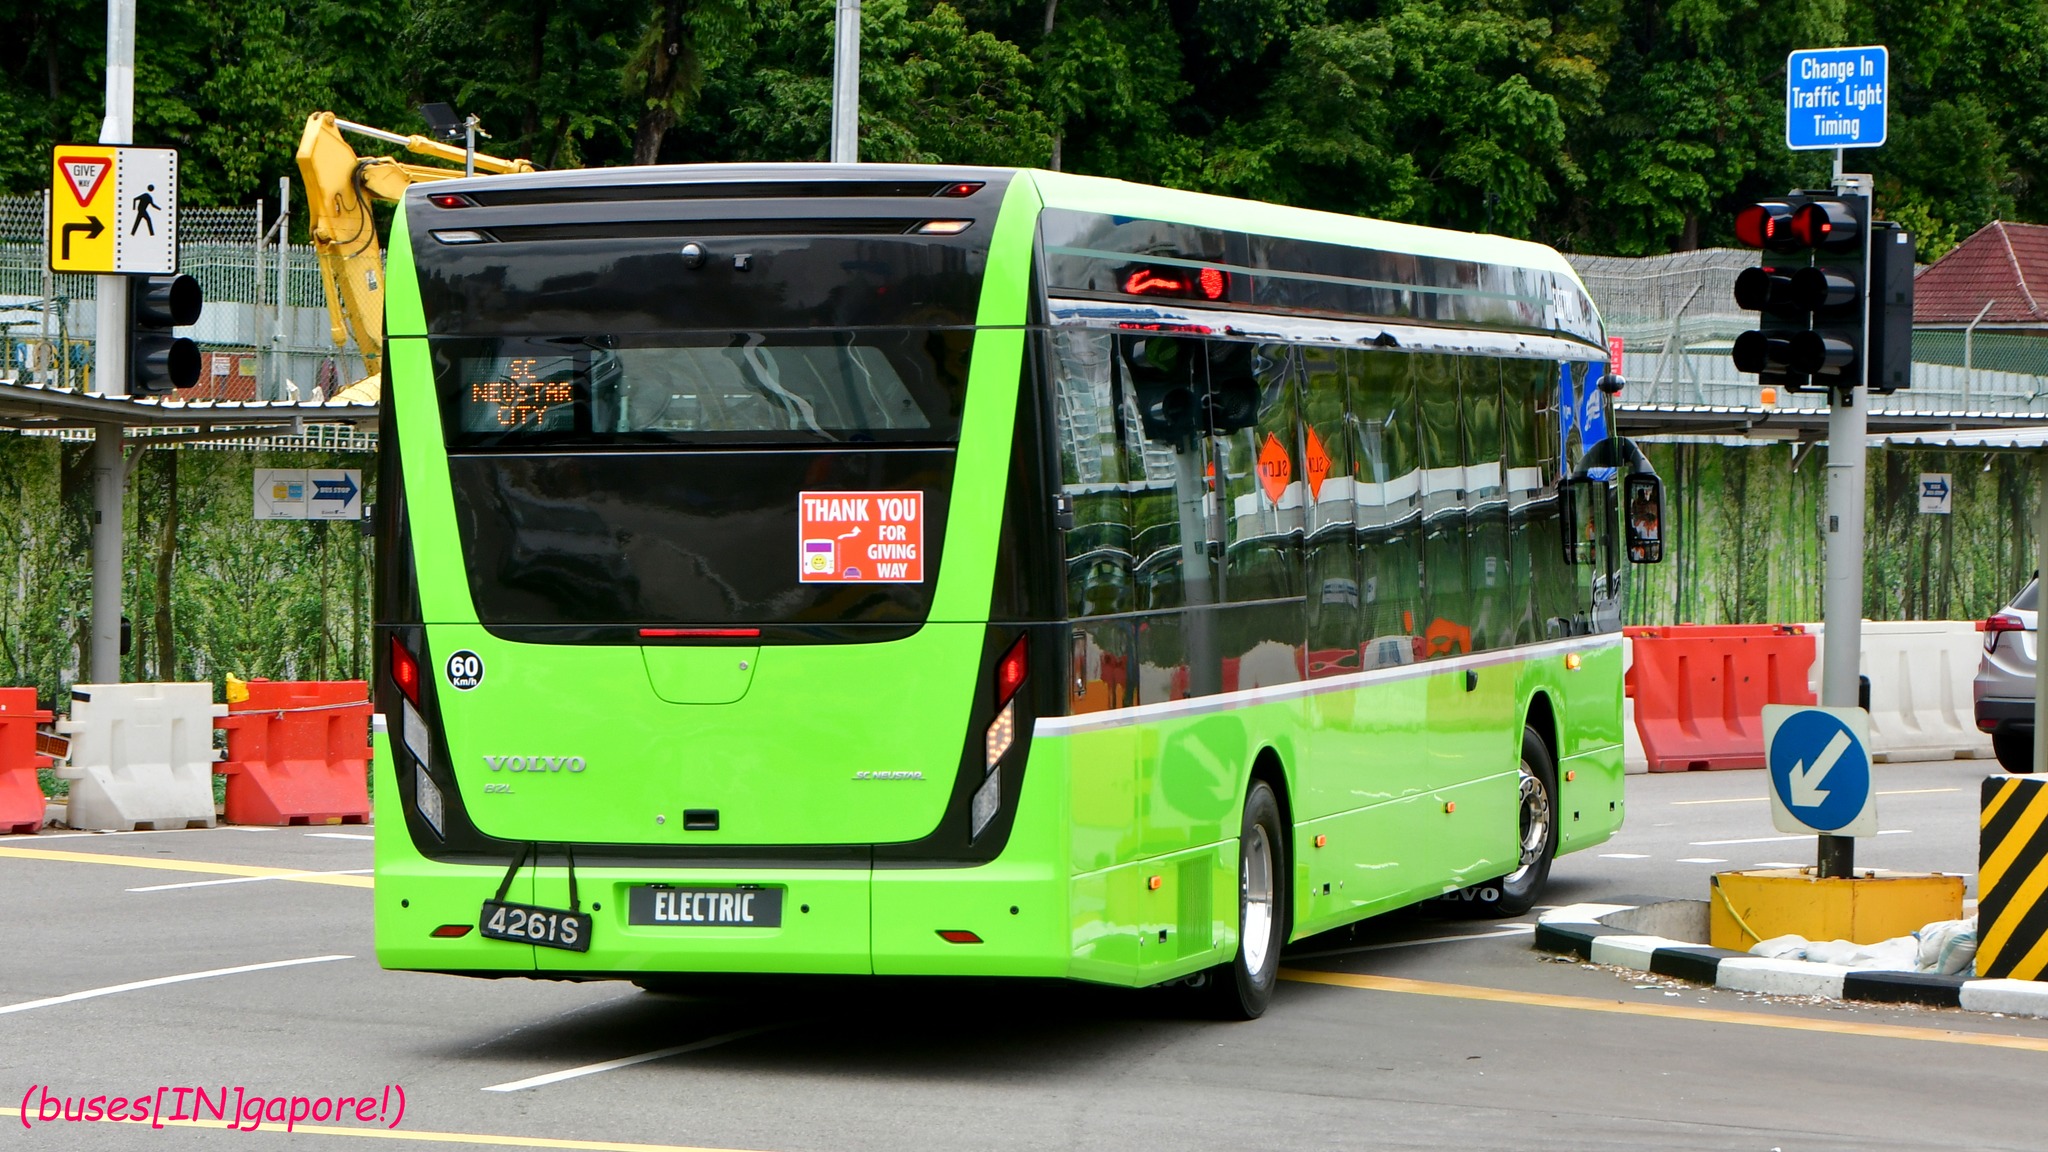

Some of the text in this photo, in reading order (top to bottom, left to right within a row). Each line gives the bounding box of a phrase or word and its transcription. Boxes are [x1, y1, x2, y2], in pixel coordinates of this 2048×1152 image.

[1801, 55, 1874, 83] Change In
[1792, 83, 1882, 111] Traffic Light
[1813, 113, 1860, 140] Timing
[73, 165, 96, 177] GIVE
[78, 179, 90, 187] WAY
[510, 359, 537, 379] SC
[471, 382, 573, 402] NEUSTAR
[497, 404, 548, 425] CITY
[333, 486, 351, 494] STOP
[804, 498, 916, 522] THANK YOU
[878, 525, 906, 541] FOR
[867, 543, 916, 560] GIVING
[876, 562, 908, 579] WAY
[450, 656, 479, 677] 60
[453, 677, 478, 686] Km/h
[483, 755, 587, 772] VOLVO
[654, 892, 755, 922] ELECTRIC
[487, 906, 579, 944] 4261S
